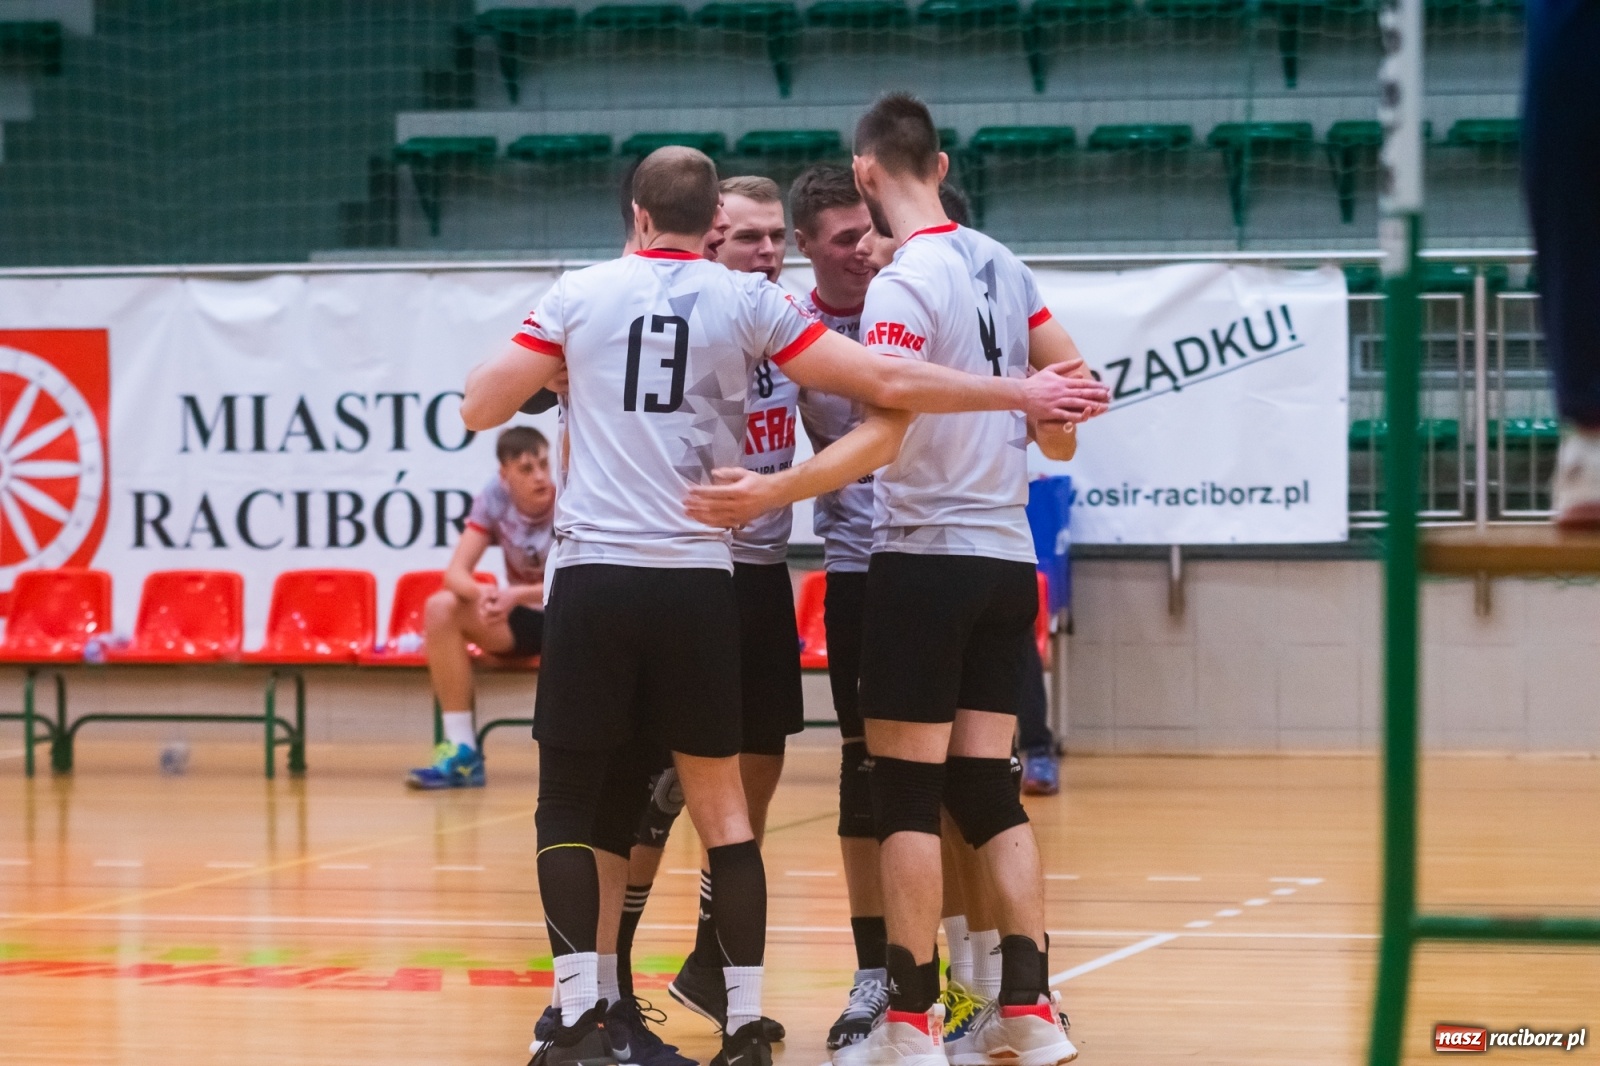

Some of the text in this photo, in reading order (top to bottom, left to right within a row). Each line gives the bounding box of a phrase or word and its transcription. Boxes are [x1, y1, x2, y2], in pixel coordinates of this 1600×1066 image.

[864, 322, 926, 352] AFAKO
[1090, 304, 1298, 400] ZĄDKU!
[623, 315, 690, 414] 13
[755, 360, 774, 399] 8
[179, 391, 477, 454] MIASTO
[1068, 480, 1310, 510] .osir-raciborz.pl
